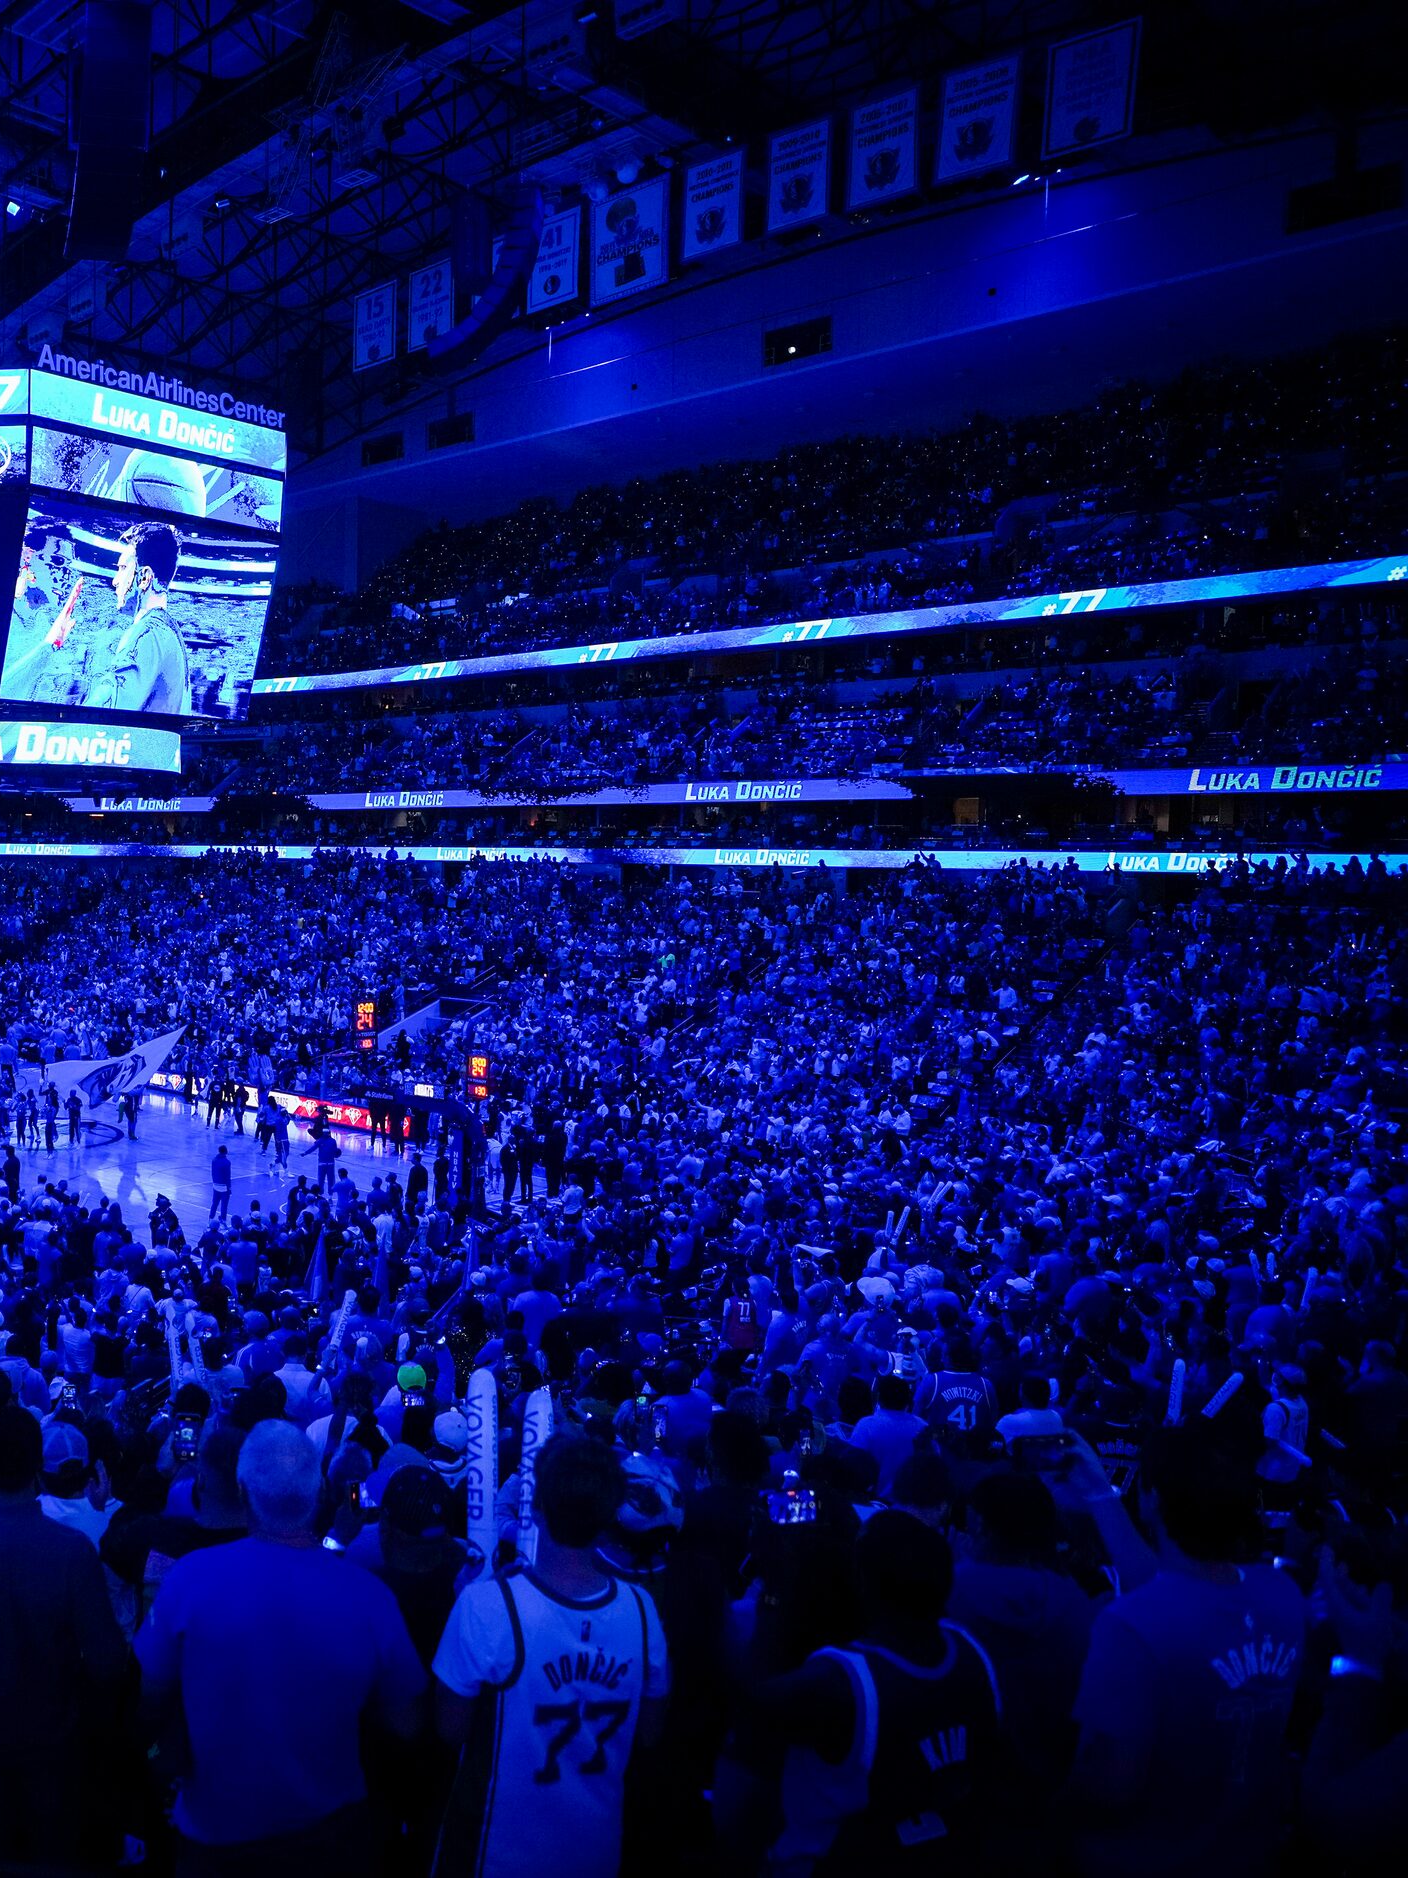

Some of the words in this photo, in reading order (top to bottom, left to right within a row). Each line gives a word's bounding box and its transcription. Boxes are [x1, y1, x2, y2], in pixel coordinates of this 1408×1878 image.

[542, 225, 563, 250] 41
[597, 233, 660, 266] CHAMPIONS
[420, 269, 443, 298] 22
[365, 295, 385, 320] 15
[92, 392, 150, 435] LUKA
[157, 408, 235, 454] DONČIĆ
[14, 725, 132, 765] DONČIĆ
[1188, 769, 1260, 791] LUKA
[1270, 764, 1383, 790] DONČIĆ
[365, 791, 395, 807] LUKA
[685, 783, 729, 801] LUKA
[714, 848, 750, 865] LUKA
[357, 1013, 373, 1030] 24
[472, 1067, 484, 1077] 24
[738, 1301, 751, 1316] 77
[941, 1385, 983, 1402] NOWITZKI
[946, 1404, 977, 1430] 41
[466, 1393, 484, 1522] VOYAGER
[543, 1647, 633, 1692] DONČIĆ
[533, 1700, 631, 1785] 77
